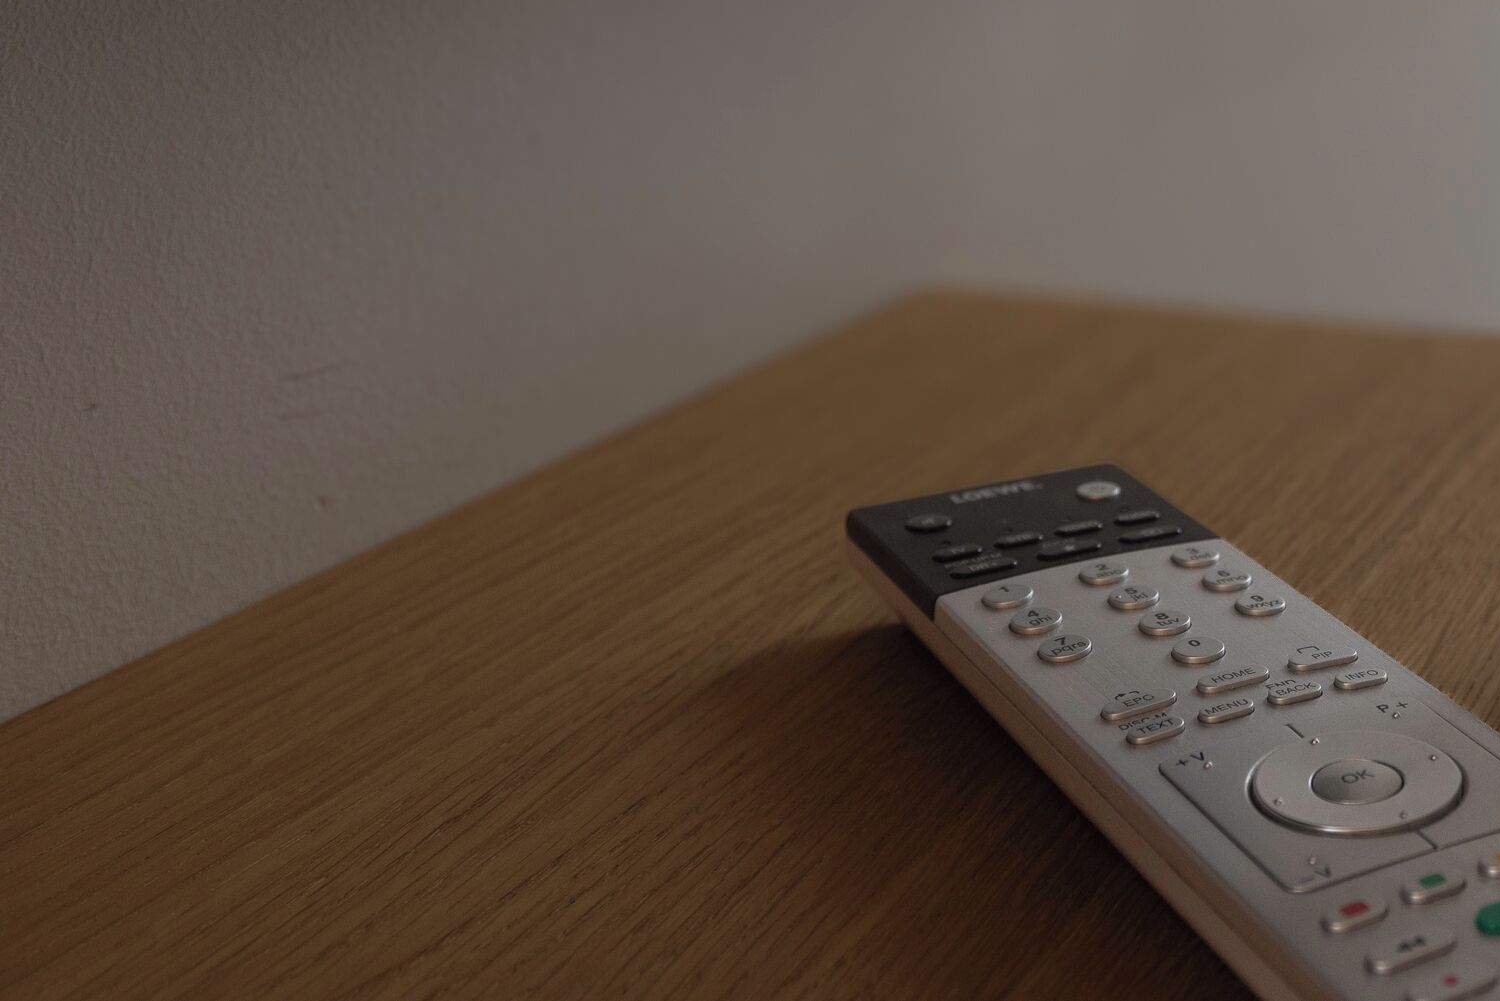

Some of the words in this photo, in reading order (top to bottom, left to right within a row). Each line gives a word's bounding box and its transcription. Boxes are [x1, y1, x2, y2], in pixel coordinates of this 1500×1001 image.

[1125, 587, 1138, 595] 5
[1027, 610, 1039, 618] 4
[1155, 612, 1169, 620] 8
[1029, 615, 1053, 627] ghi
[1157, 617, 1180, 626] tuv
[1054, 637, 1067, 645] 7
[1188, 639, 1201, 647] 0
[1051, 641, 1087, 656] pqrs
[1311, 650, 1333, 660] PIP
[1211, 667, 1256, 683] HOME
[1344, 669, 1379, 681] INFO
[1275, 681, 1317, 696] BACK
[1204, 699, 1248, 715] MENU
[1138, 718, 1174, 734] TEXT
[1341, 769, 1376, 785] OK
